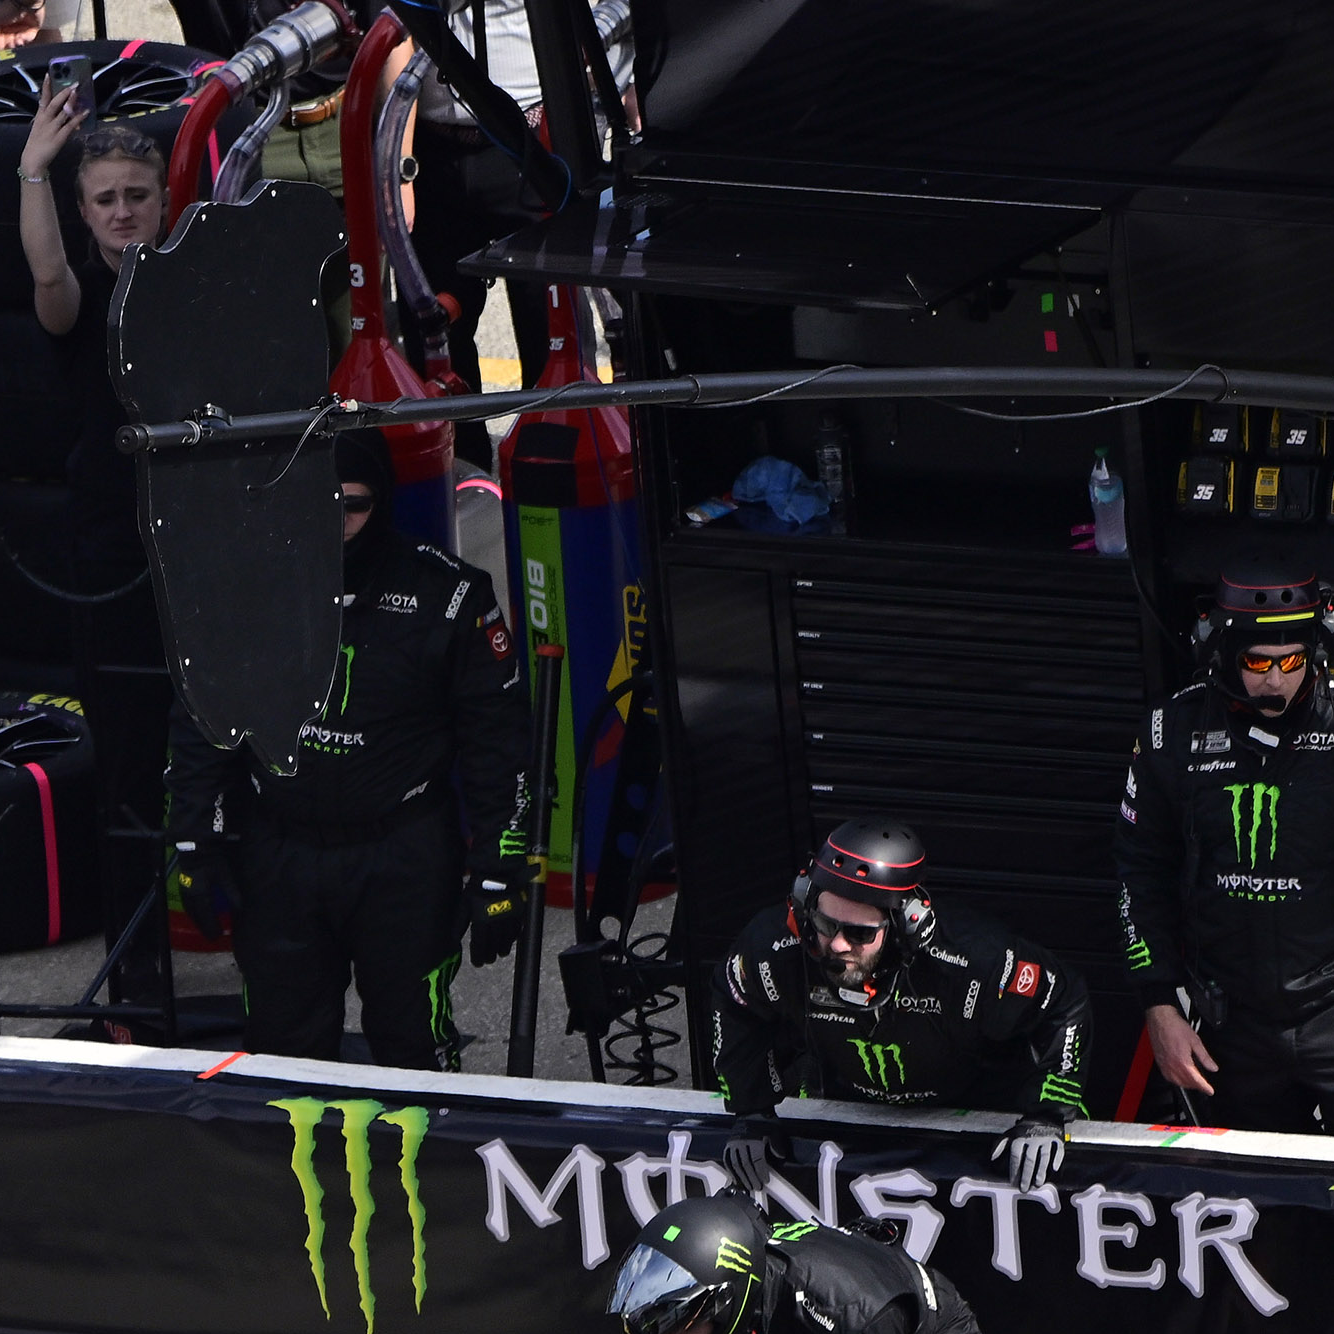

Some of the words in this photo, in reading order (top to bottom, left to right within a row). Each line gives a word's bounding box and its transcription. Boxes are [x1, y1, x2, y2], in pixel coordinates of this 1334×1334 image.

[349, 263, 365, 288] 3
[548, 285, 559, 308] 1
[549, 336, 565, 351] 35
[1209, 428, 1230, 443] 35
[1286, 429, 1309, 446] 35
[1193, 484, 1215, 501] 35
[301, 725, 366, 747] ONSTER
[1151, 708, 1164, 749] sparco
[302, 740, 351, 756] NERGY
[1216, 872, 1302, 892] MONSTER
[1228, 892, 1287, 903] ENERGY
[780, 935, 801, 948] Colu
[929, 945, 969, 968] Columbia
[758, 960, 780, 1002] sparco
[963, 979, 981, 1020] sparco
[806, 1012, 855, 1025] OODYEAR
[802, 1299, 835, 1332] Columbia
